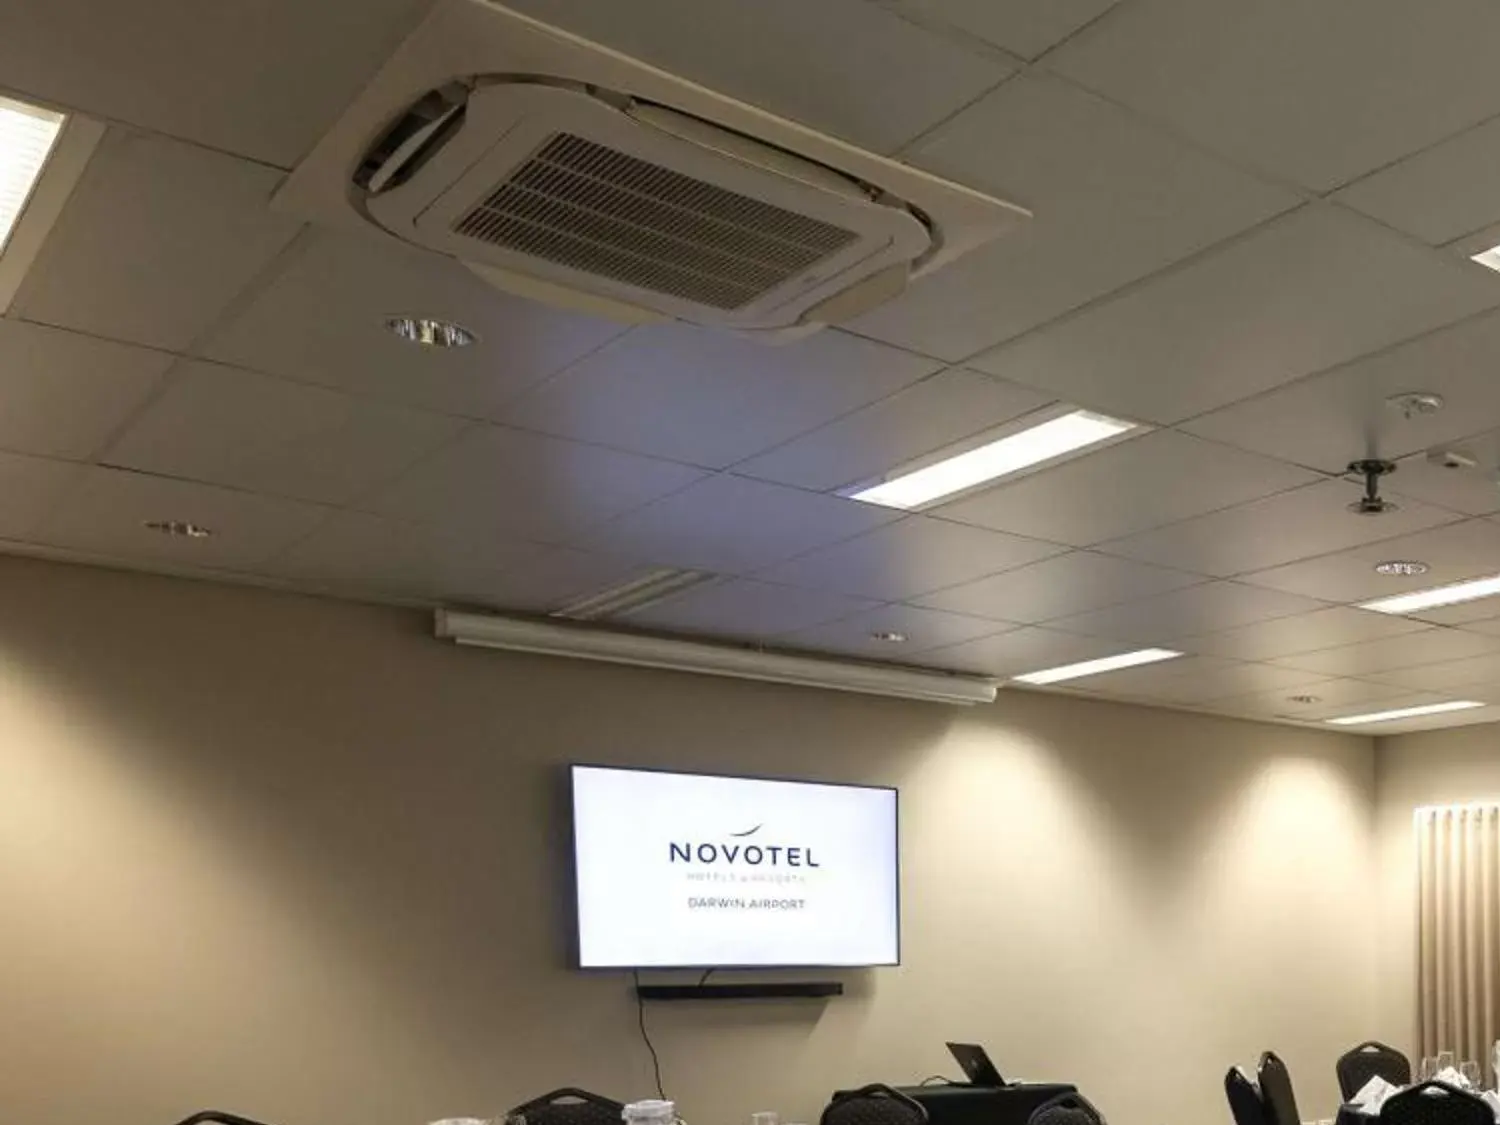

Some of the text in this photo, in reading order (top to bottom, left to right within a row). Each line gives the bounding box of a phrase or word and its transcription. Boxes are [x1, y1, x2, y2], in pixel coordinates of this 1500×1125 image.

[669, 842, 819, 868] NOVOTEL
[687, 897, 805, 910] DARWIN AIRPORT
